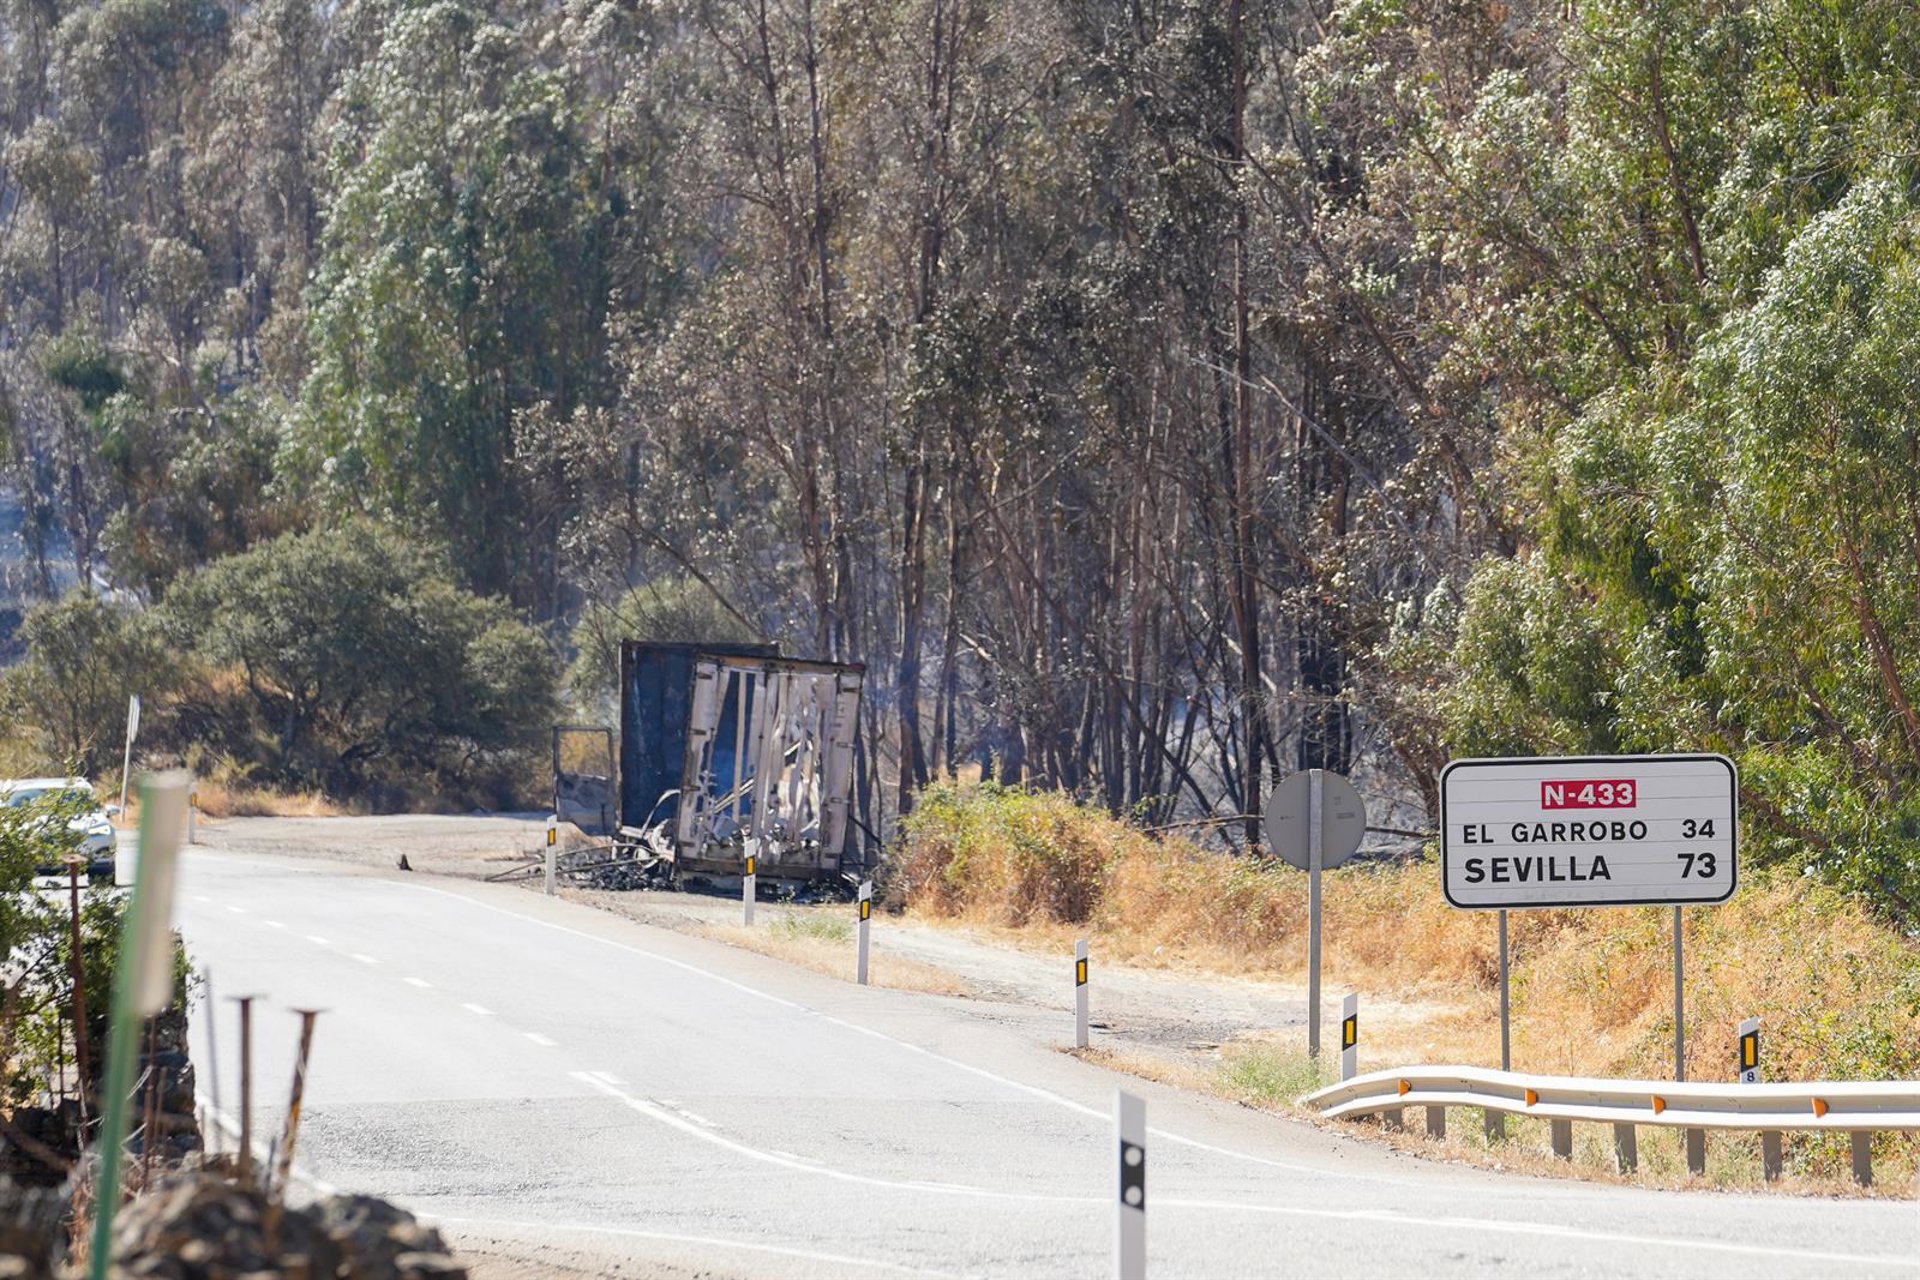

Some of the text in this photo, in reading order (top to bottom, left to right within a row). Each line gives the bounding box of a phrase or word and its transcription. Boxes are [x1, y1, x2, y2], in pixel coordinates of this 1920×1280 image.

[1544, 783, 1633, 806] N-433
[1463, 819, 1715, 843] EL GARROBO 34
[1464, 853, 1717, 883] SEVILLA 73
[1746, 1071, 1755, 1082] 8
